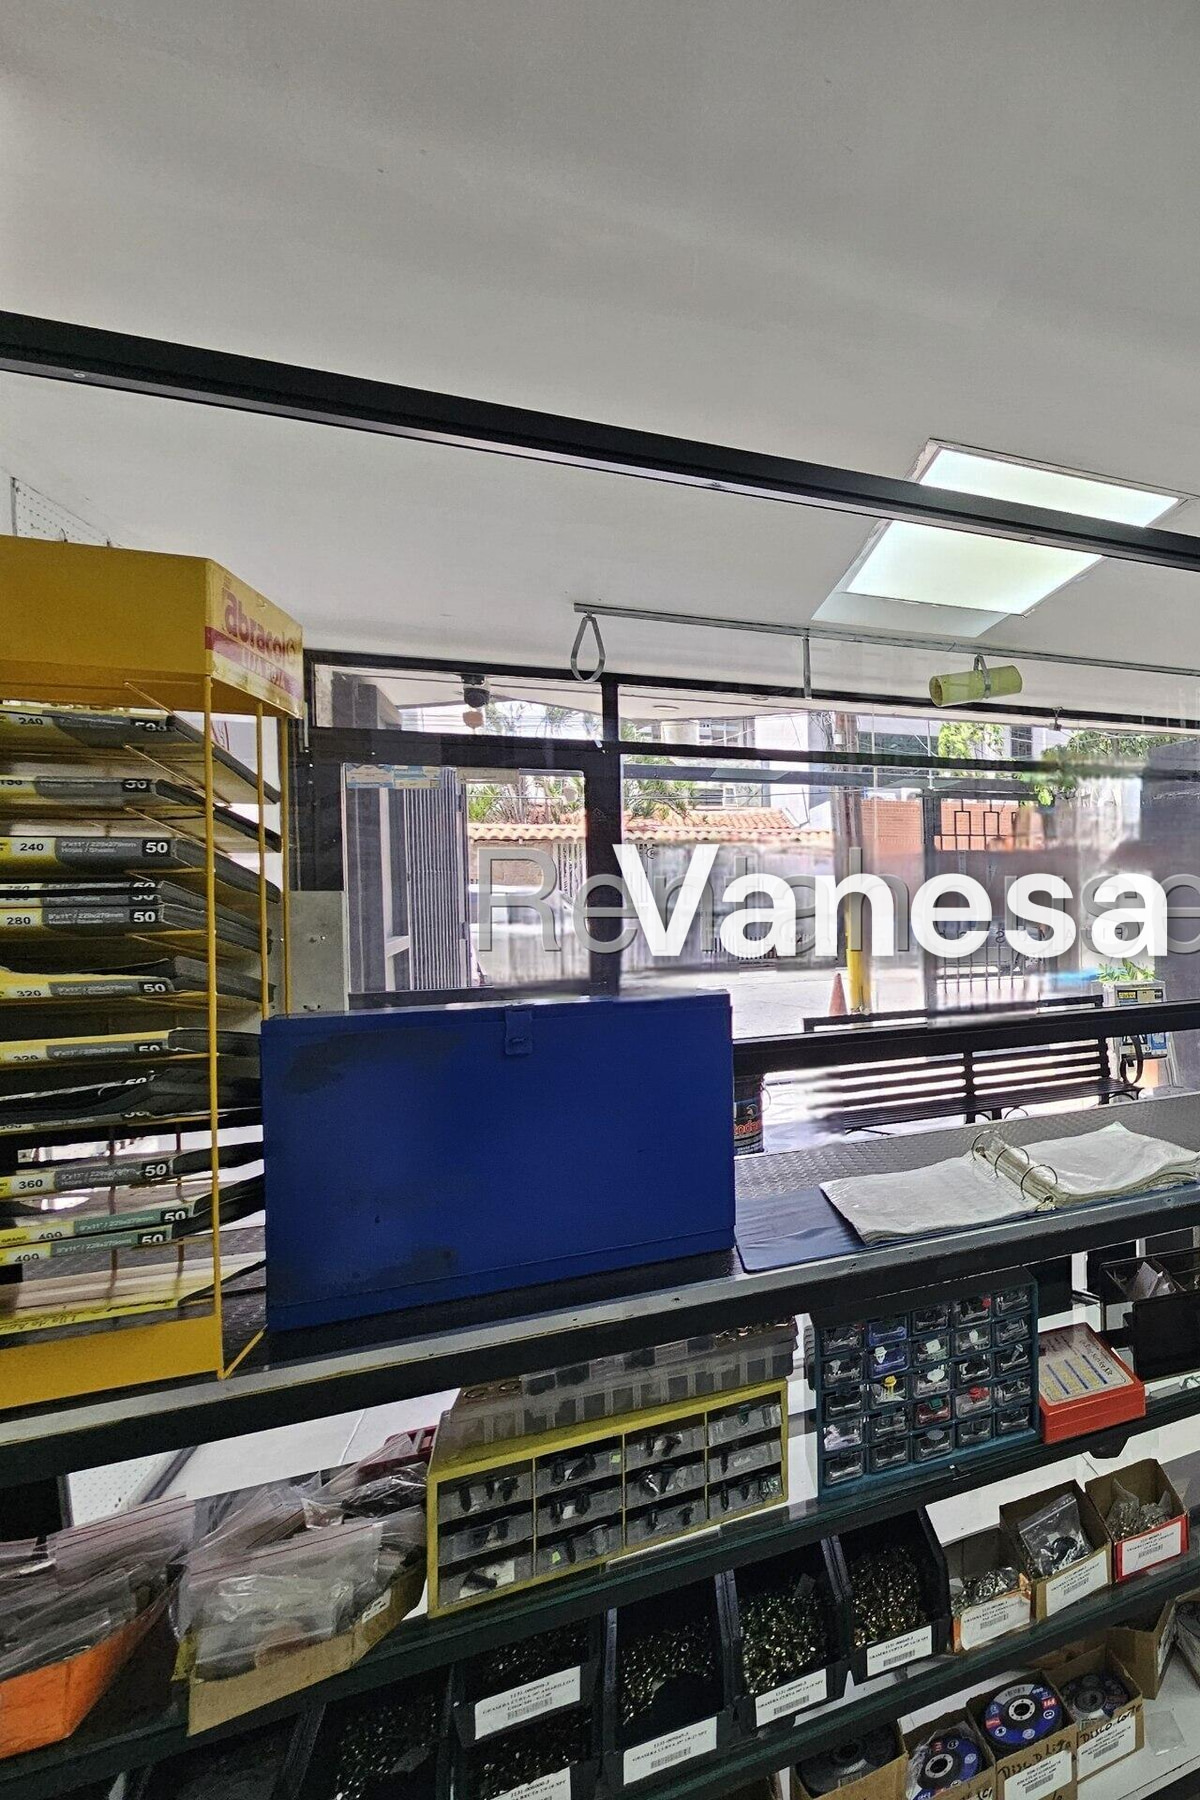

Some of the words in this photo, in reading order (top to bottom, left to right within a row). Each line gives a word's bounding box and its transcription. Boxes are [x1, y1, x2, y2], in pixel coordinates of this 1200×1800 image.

[20, 842, 44, 851] 240
[145, 842, 168, 853] 50
[7, 917, 31, 925] 280
[133, 911, 157, 923] 50
[143, 984, 166, 993] 50
[144, 1164, 167, 1177] 50
[18, 1179, 43, 1190] 360
[164, 1209, 188, 1221] 50
[38, 1230, 63, 1240] 400
[141, 1235, 164, 1244] 50
